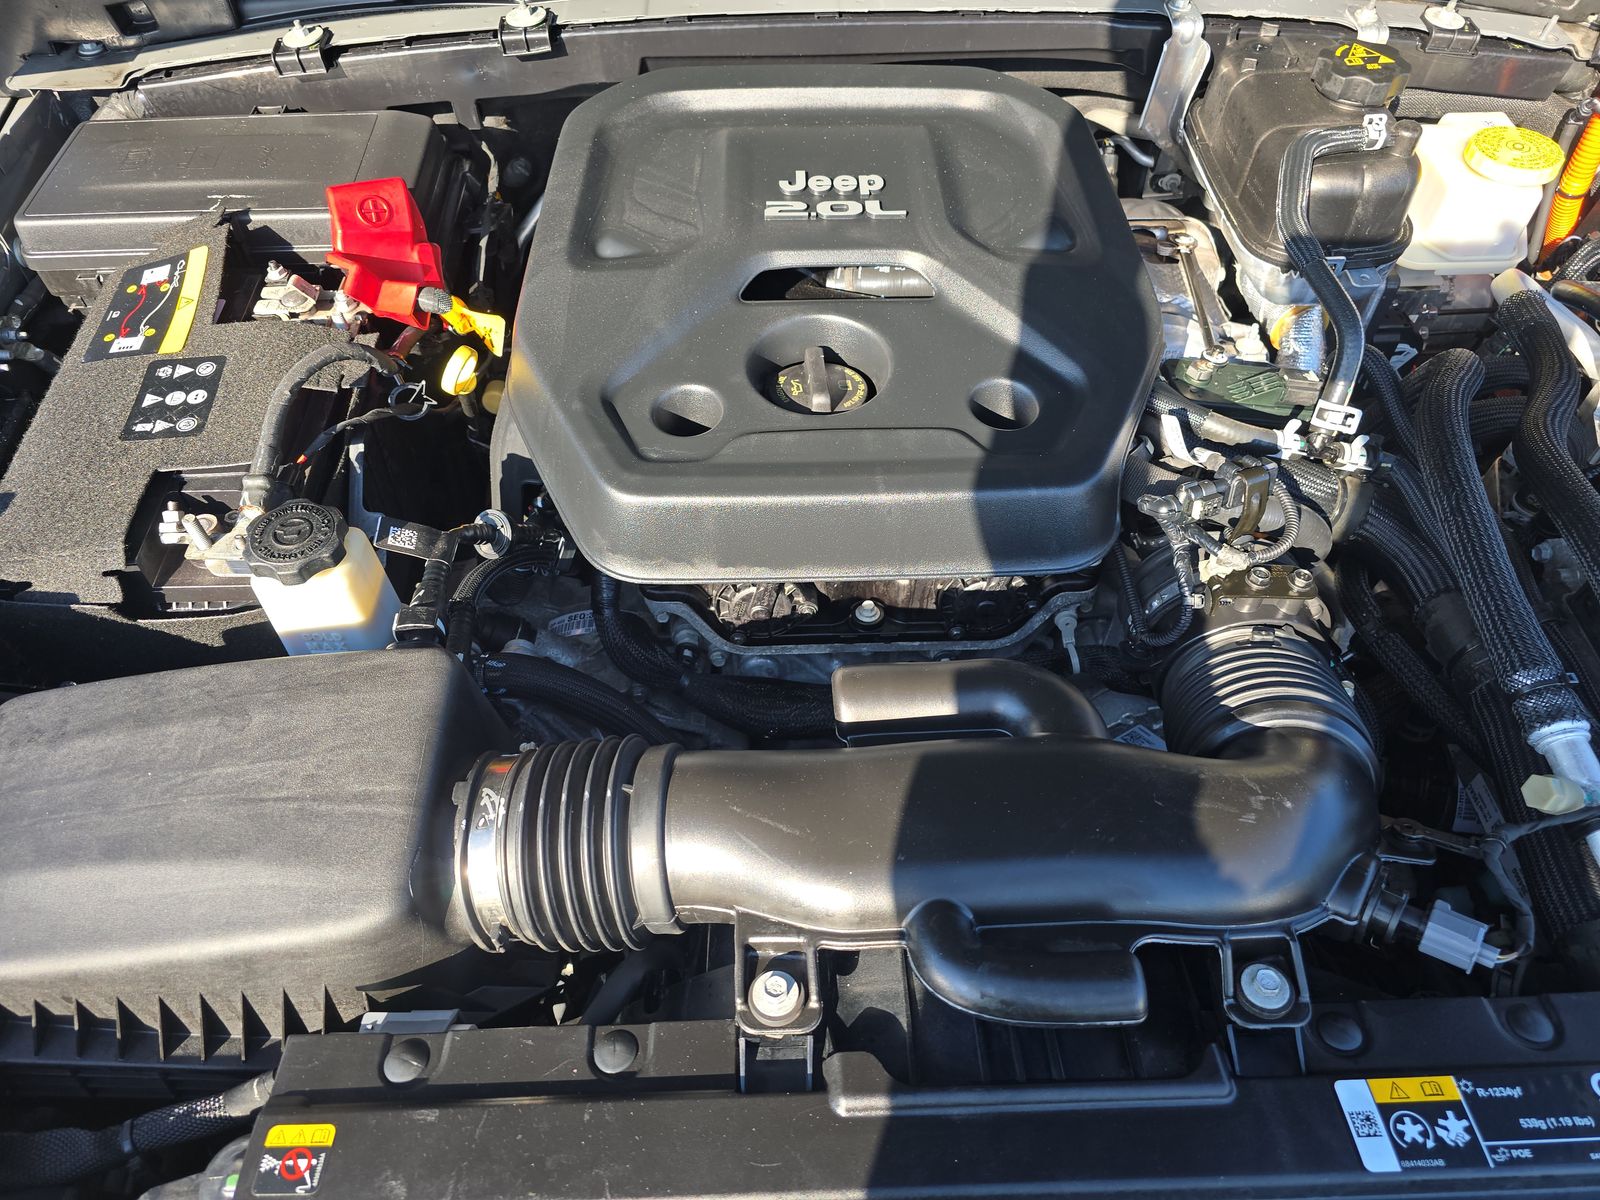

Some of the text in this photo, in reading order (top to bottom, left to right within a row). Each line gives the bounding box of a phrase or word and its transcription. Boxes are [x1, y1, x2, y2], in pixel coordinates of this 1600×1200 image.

[779, 170, 885, 198] Jeep
[764, 200, 907, 220] 2.0L
[1476, 1086, 1523, 1099] R-1234yf
